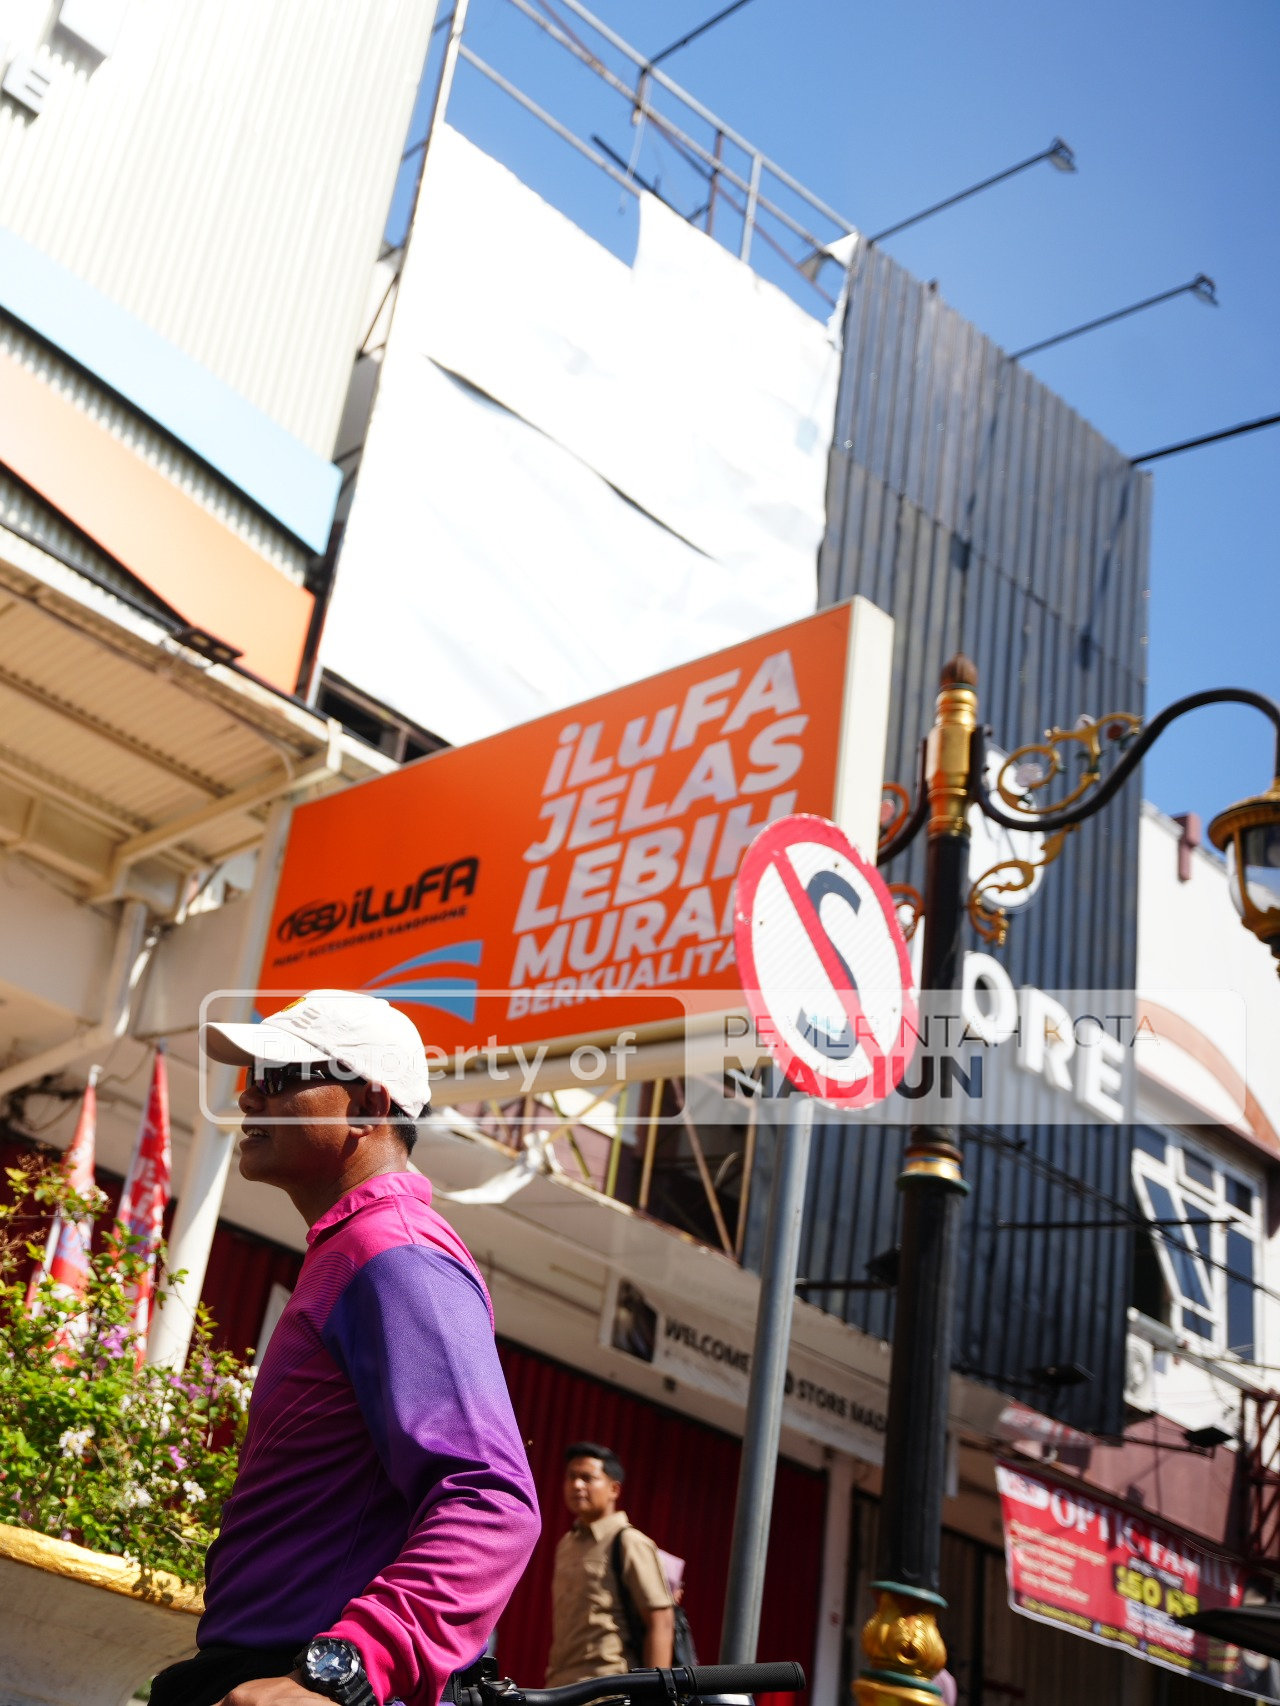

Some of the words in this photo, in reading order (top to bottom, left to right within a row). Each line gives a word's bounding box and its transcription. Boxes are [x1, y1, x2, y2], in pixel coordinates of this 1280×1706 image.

[523, 714, 810, 863] JELAS
[509, 880, 735, 989] MURA
[665, 1318, 751, 1374] WELCOME
[797, 1378, 847, 1418] STORE
[1050, 1486, 1146, 1556] OPTIC
[1148, 1526, 1241, 1601] FAMILY
